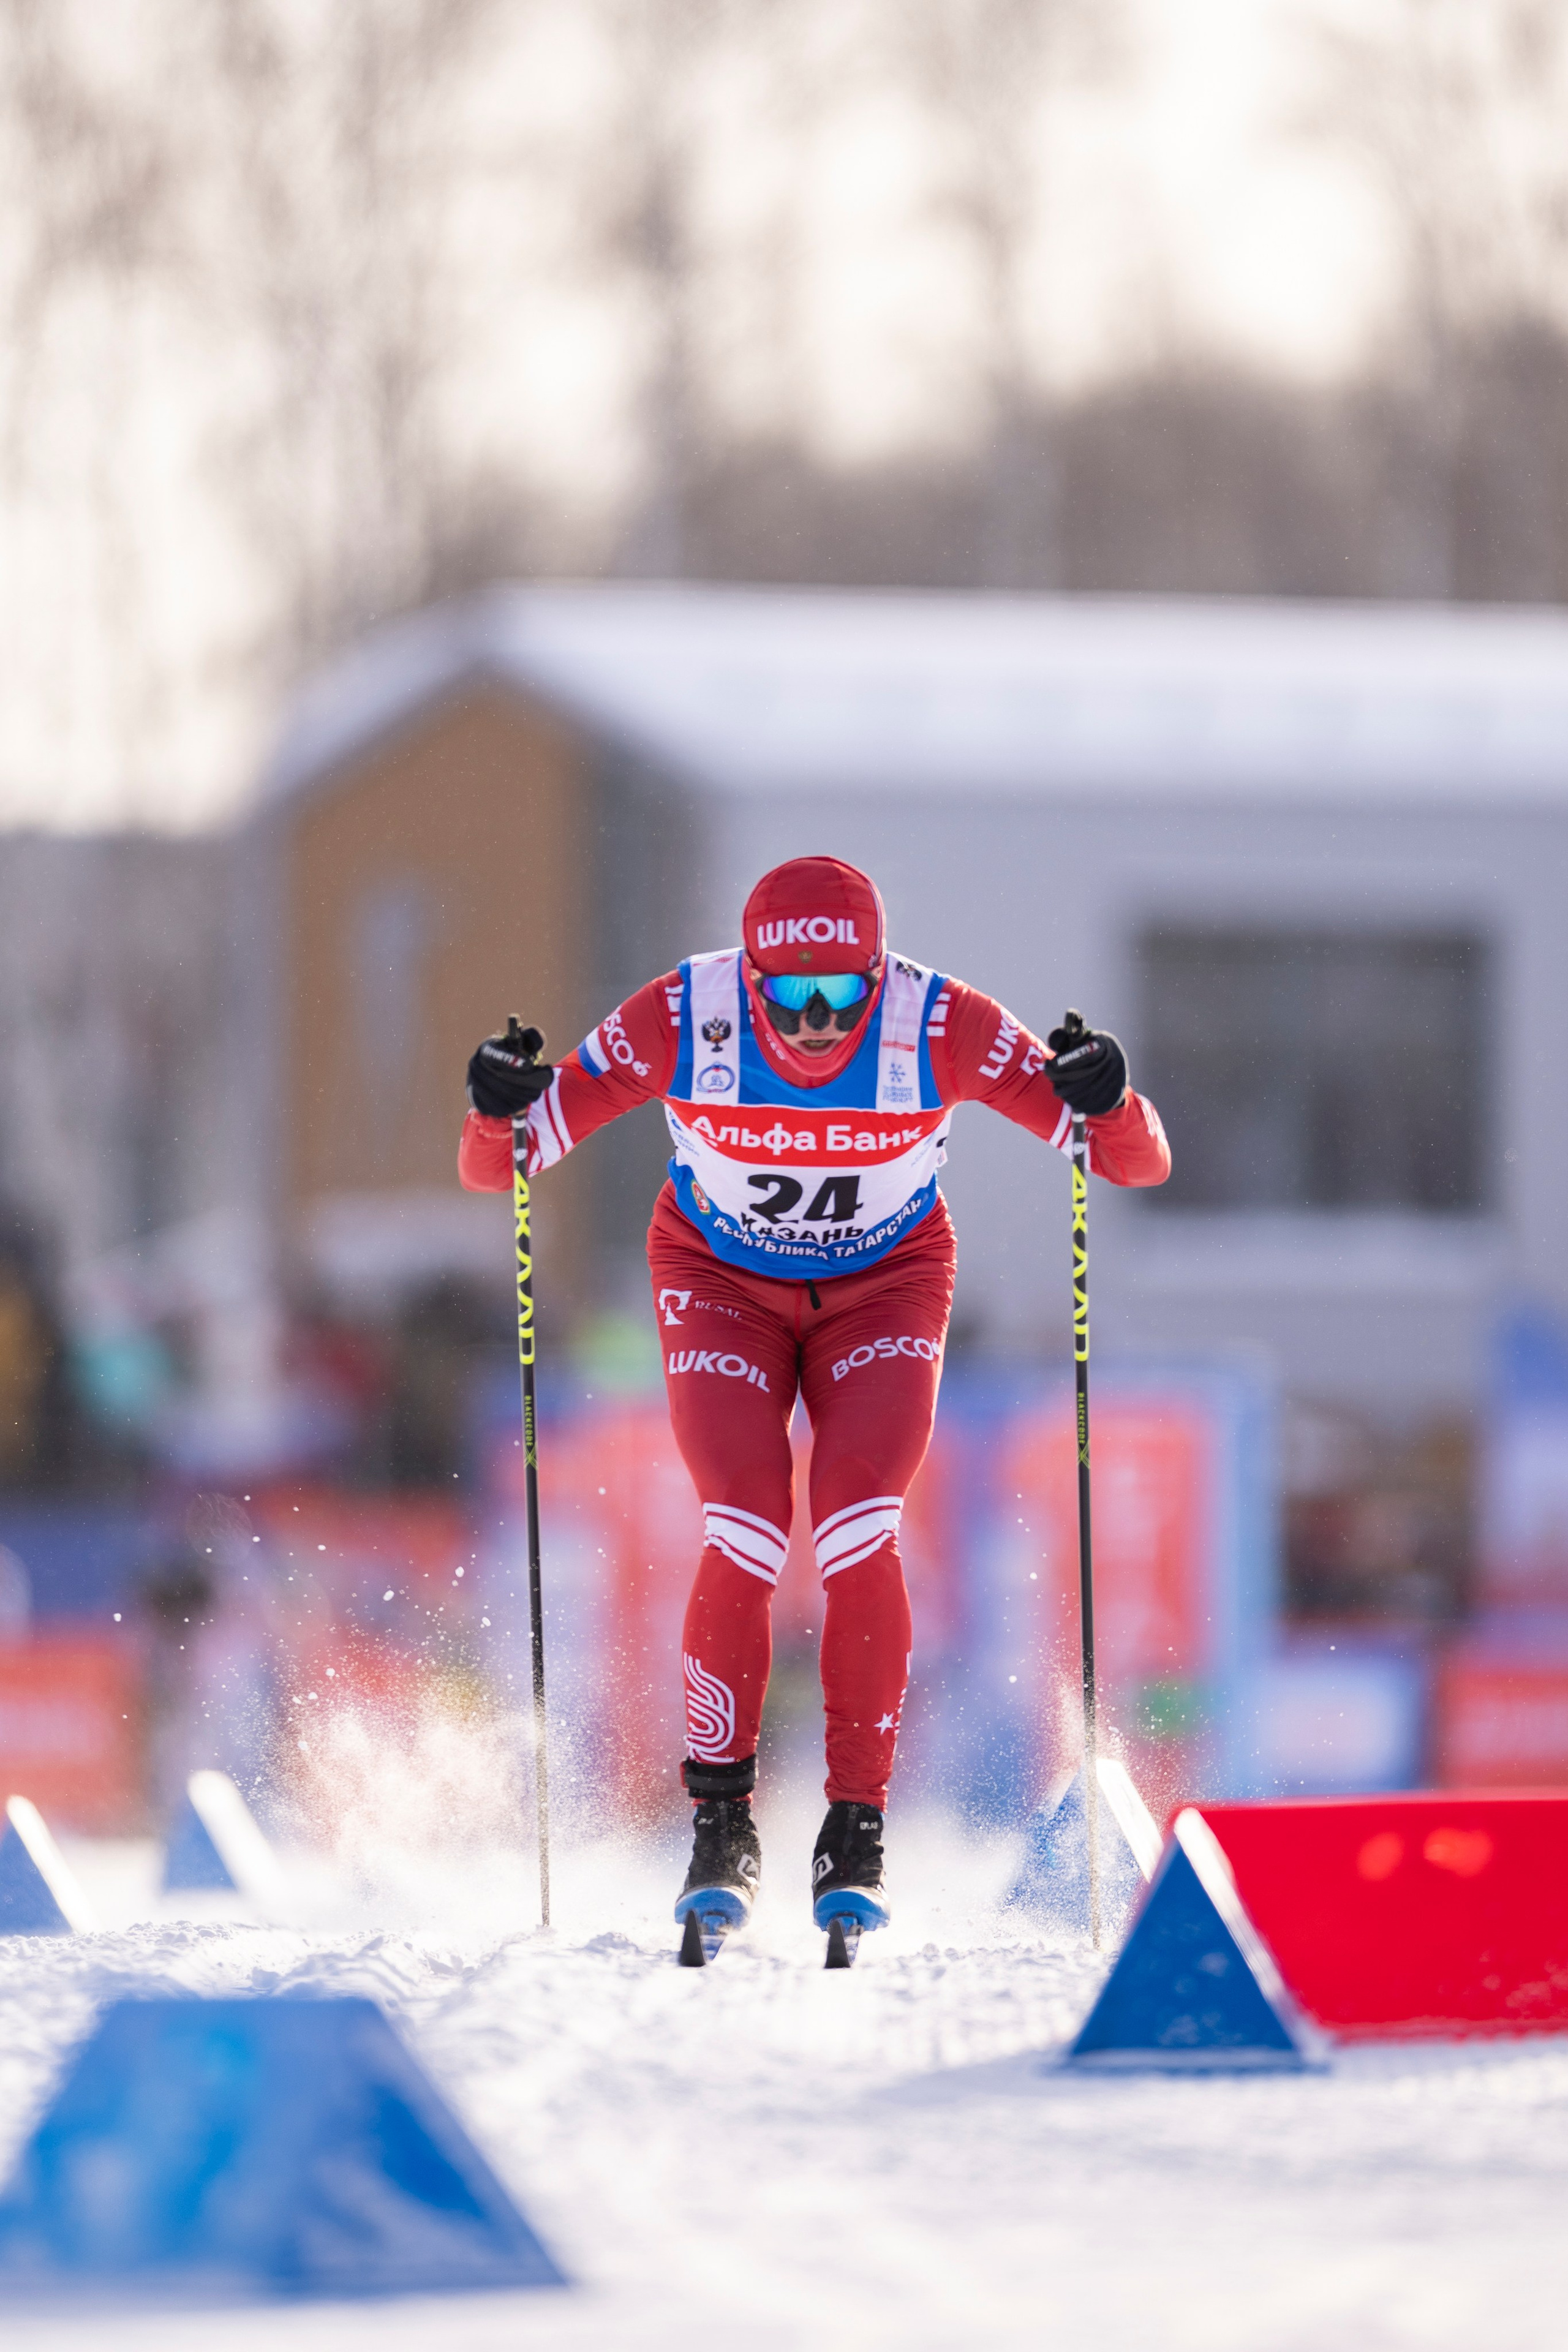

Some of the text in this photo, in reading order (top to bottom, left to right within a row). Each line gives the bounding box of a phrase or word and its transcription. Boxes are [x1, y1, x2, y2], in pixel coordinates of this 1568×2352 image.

[757, 916, 859, 949] LUKOIL
[603, 1005, 635, 1065] SCO
[691, 1115, 817, 1156] Альфа
[826, 1125, 923, 1152] Банк
[747, 1174, 864, 1224] 24
[713, 1198, 922, 1261] РЕСПУБЛИКА ТАТАРСТАН
[741, 1212, 864, 1246] КАЗАНЬ
[668, 1350, 771, 1393] LUKOIL
[831, 1336, 935, 1382] BOSCO
